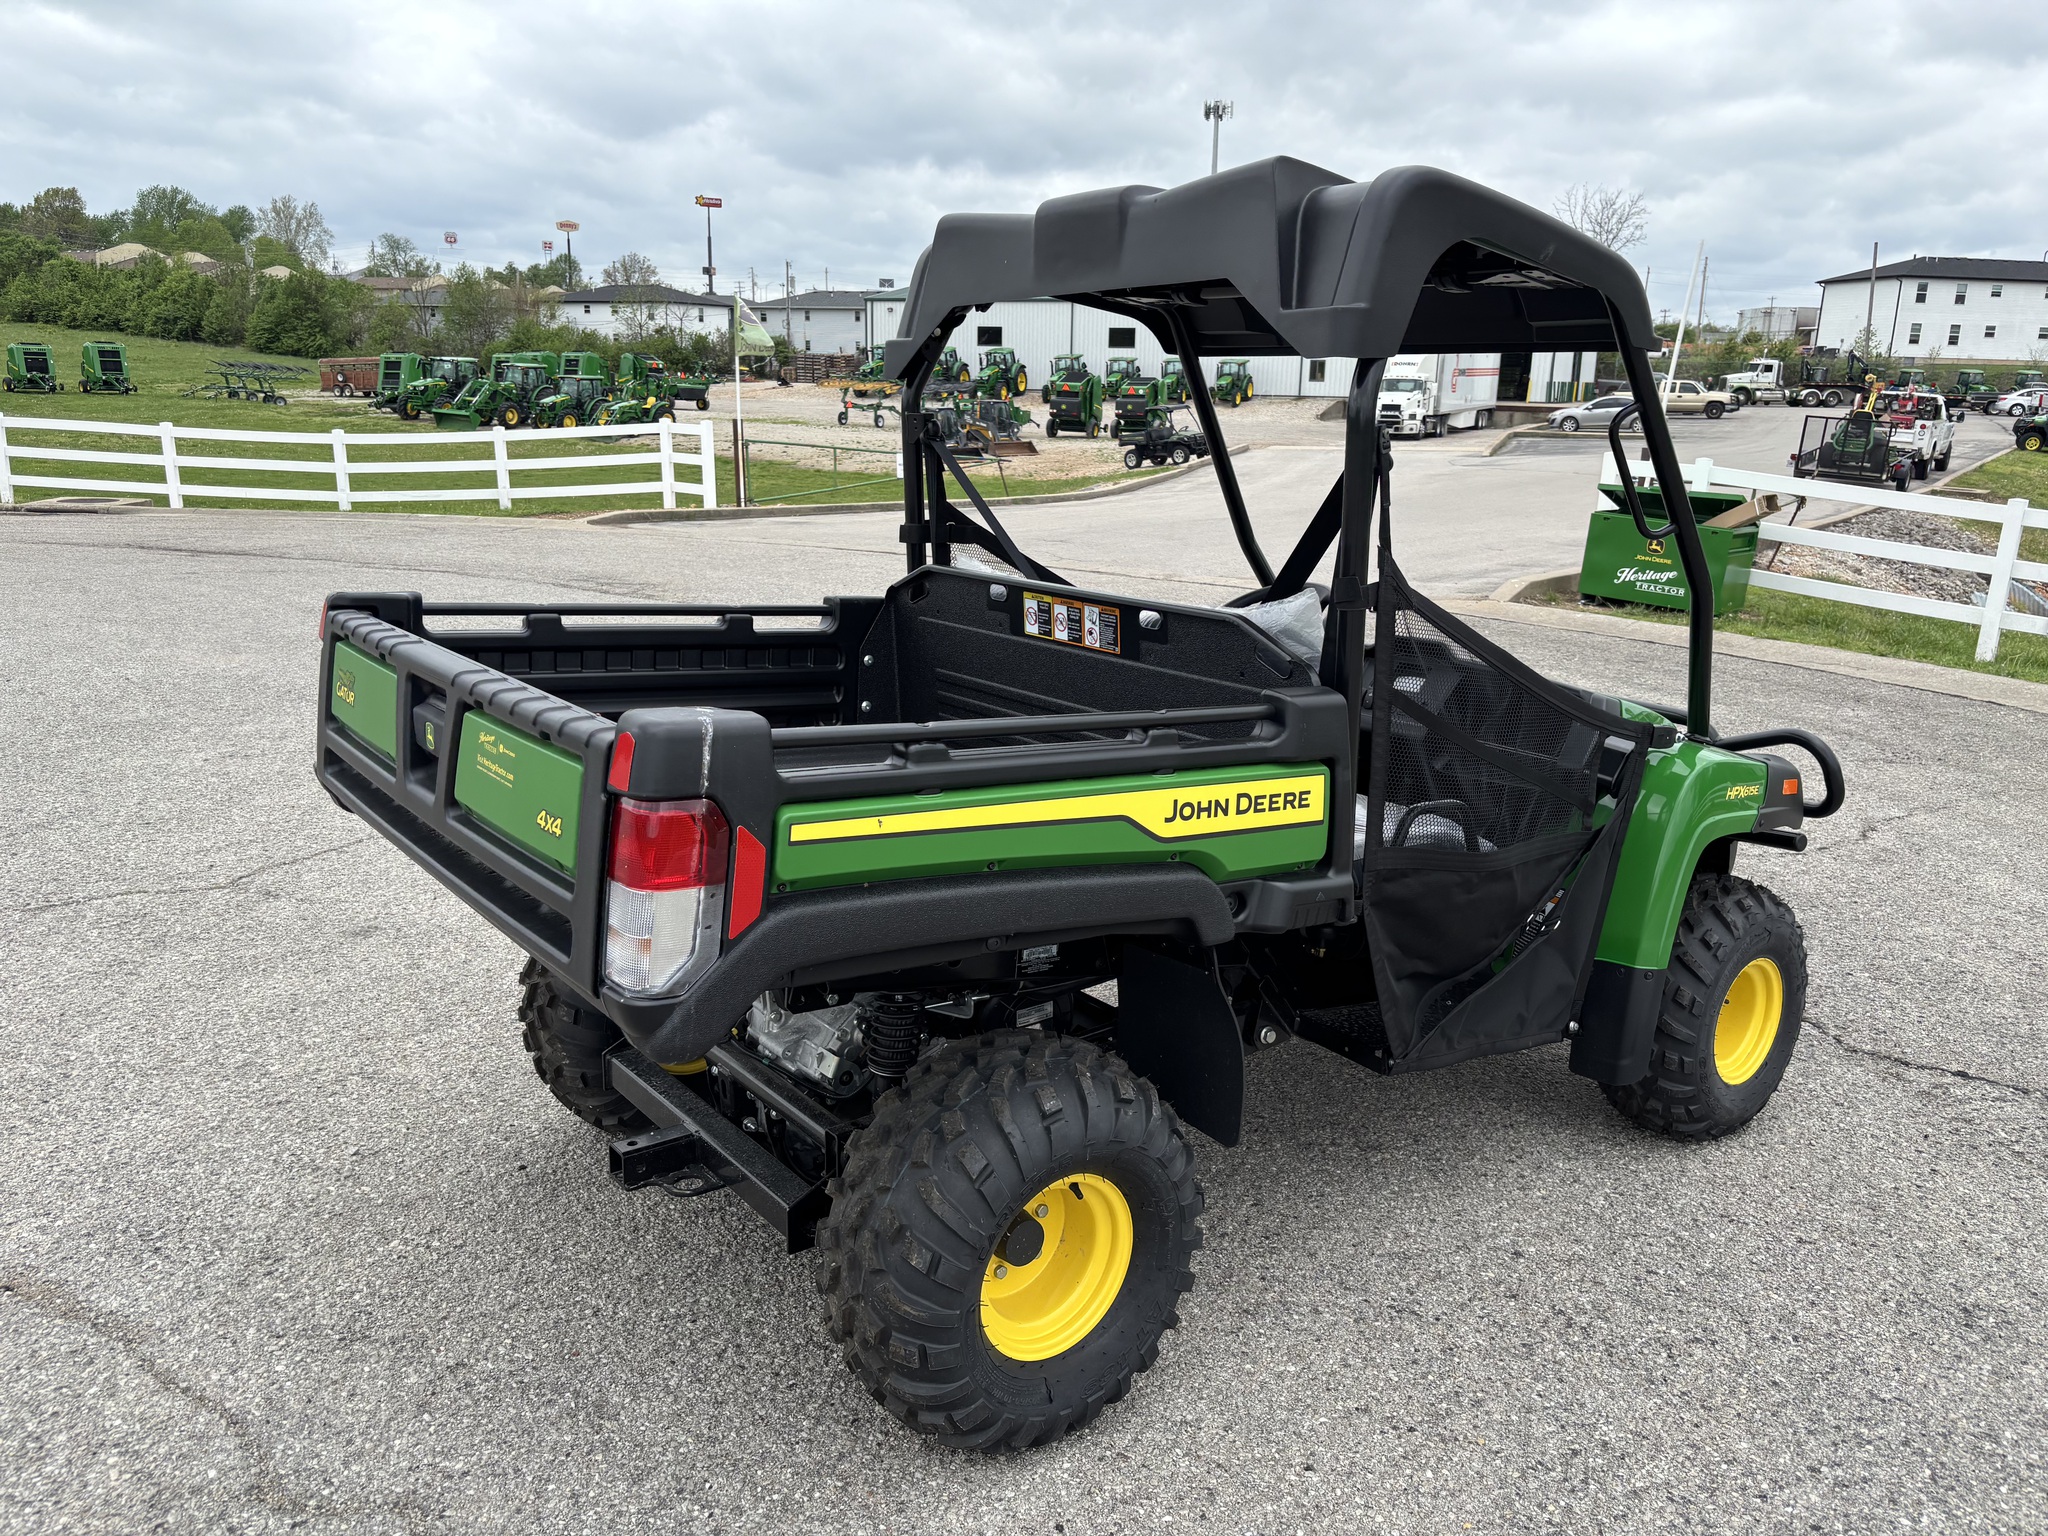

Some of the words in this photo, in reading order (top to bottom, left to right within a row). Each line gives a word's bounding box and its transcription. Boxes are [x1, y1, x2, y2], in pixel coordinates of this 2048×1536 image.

[1634, 554, 1652, 562] JOHN
[1652, 556, 1672, 565] DEERE
[1613, 567, 1678, 584] Heritage
[1635, 582, 1685, 597] TRACTOR
[336, 681, 355, 707] GATOR
[1725, 785, 1760, 801] HPX615E
[1164, 798, 1230, 824] JOHN
[1235, 790, 1312, 816] DEERE
